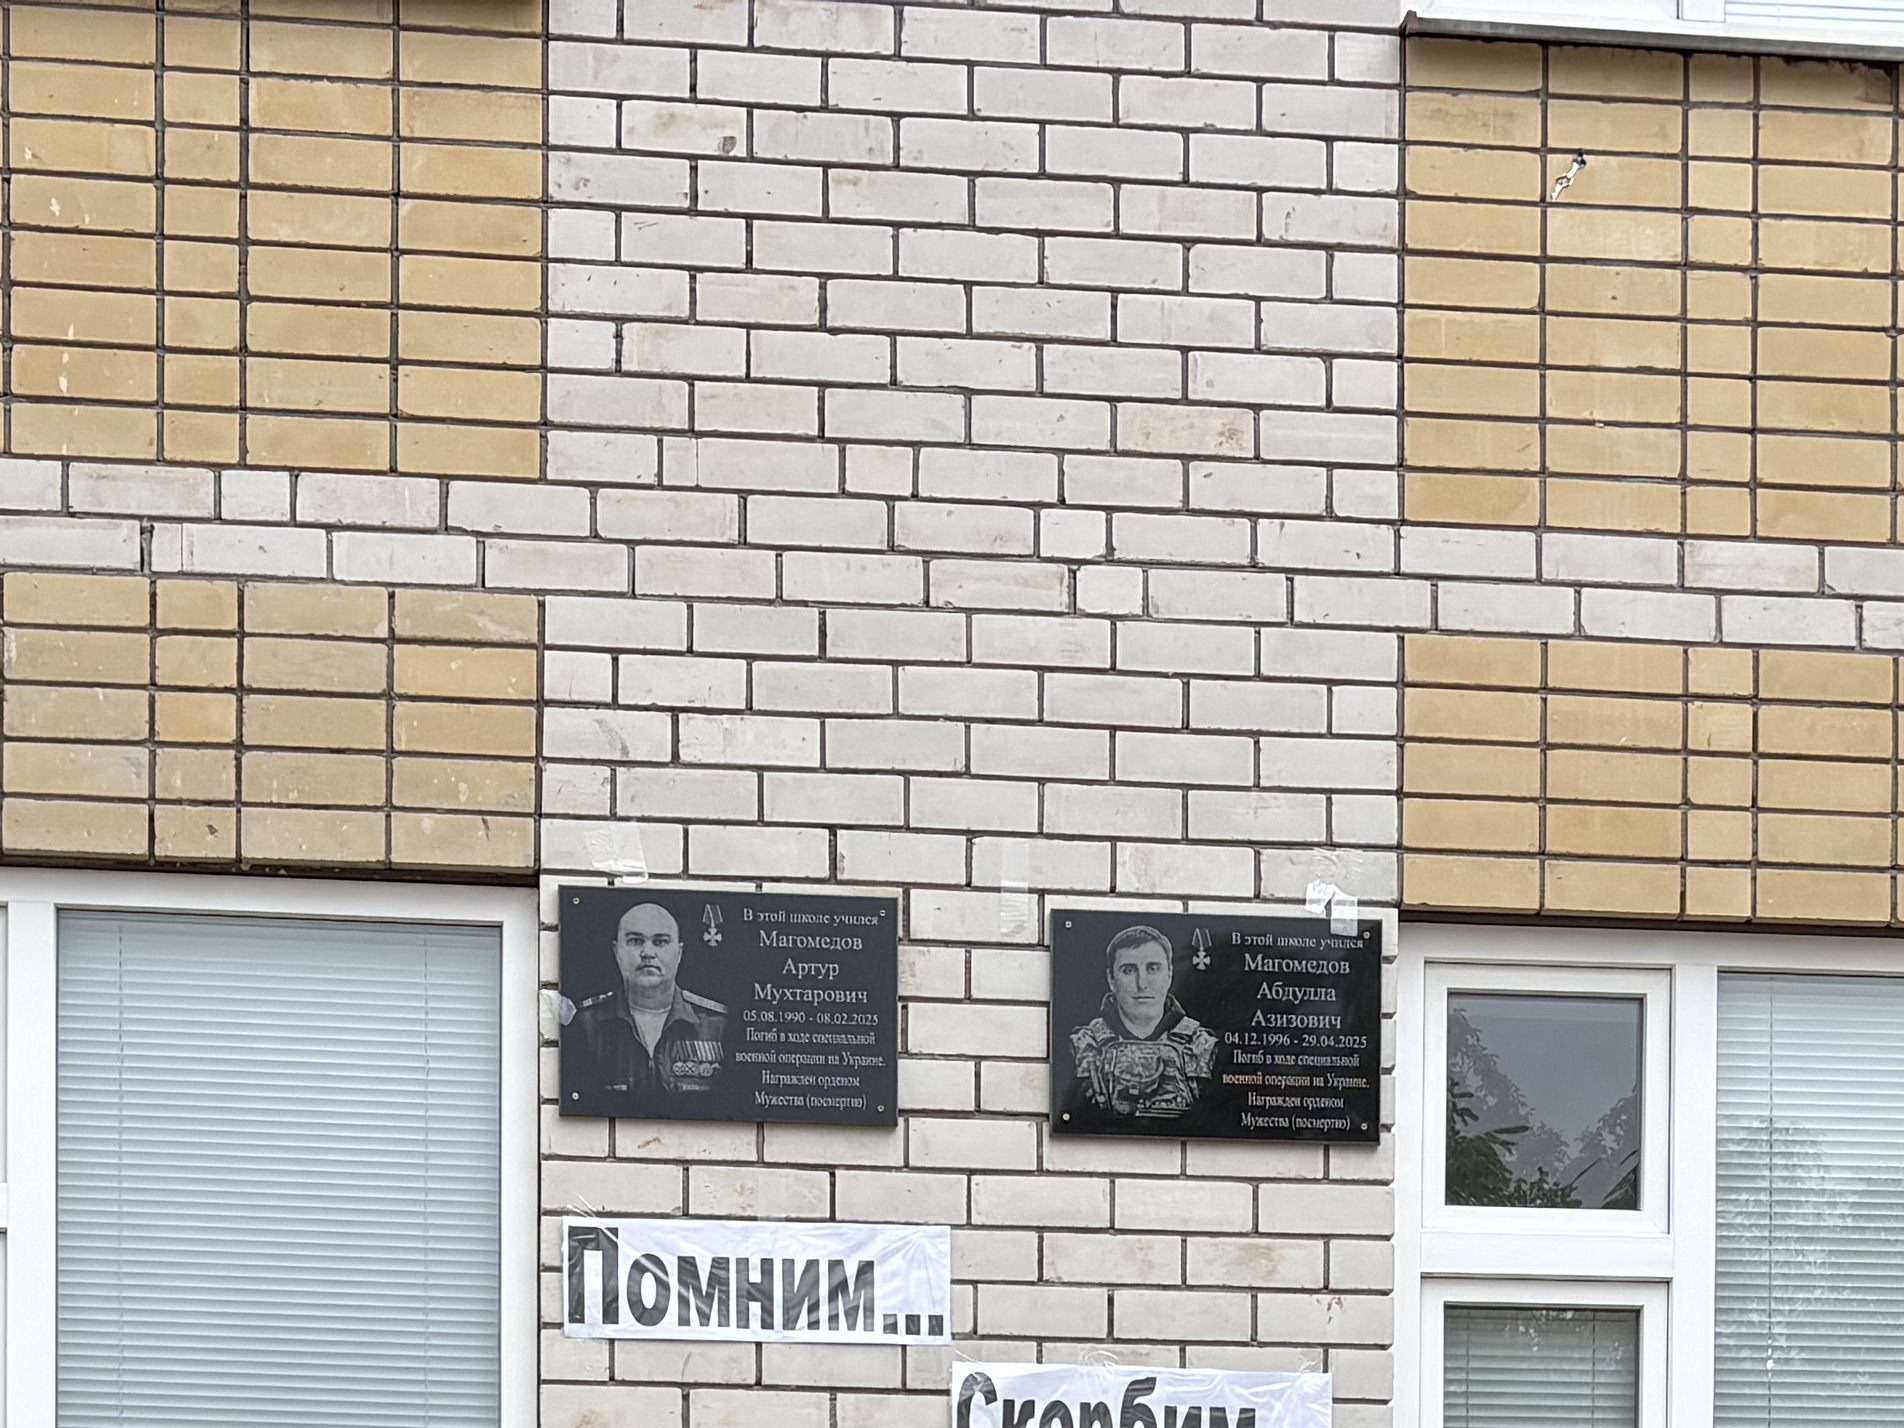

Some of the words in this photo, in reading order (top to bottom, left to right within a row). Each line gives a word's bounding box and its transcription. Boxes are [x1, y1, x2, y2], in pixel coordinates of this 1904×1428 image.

[743, 908, 753, 921] В
[757, 911, 786, 923] этой
[790, 913, 831, 924] школе
[833, 914, 879, 926] учился
[759, 929, 863, 950] Магомедов
[1231, 932, 1241, 945] В
[1245, 934, 1273, 946] этой
[1277, 936, 1316, 948] школе
[1319, 938, 1364, 950] учился
[782, 958, 840, 980] Артур
[1244, 953, 1350, 975] Магомедов
[753, 983, 868, 1006] Мухтарович
[1256, 981, 1337, 1004] Абдулла
[743, 1010, 806, 1023] 05.08.1990
[816, 1012, 879, 1026] 08.02.2025
[1251, 1008, 1342, 1029] Азизович
[746, 1027, 778, 1042] Погиб
[1224, 1032, 1291, 1046] 04.12.1996
[1302, 1034, 1368, 1049] 29.04.2025
[1233, 1049, 1264, 1064] Погиб
[566, 1225, 946, 1337] Помним...
